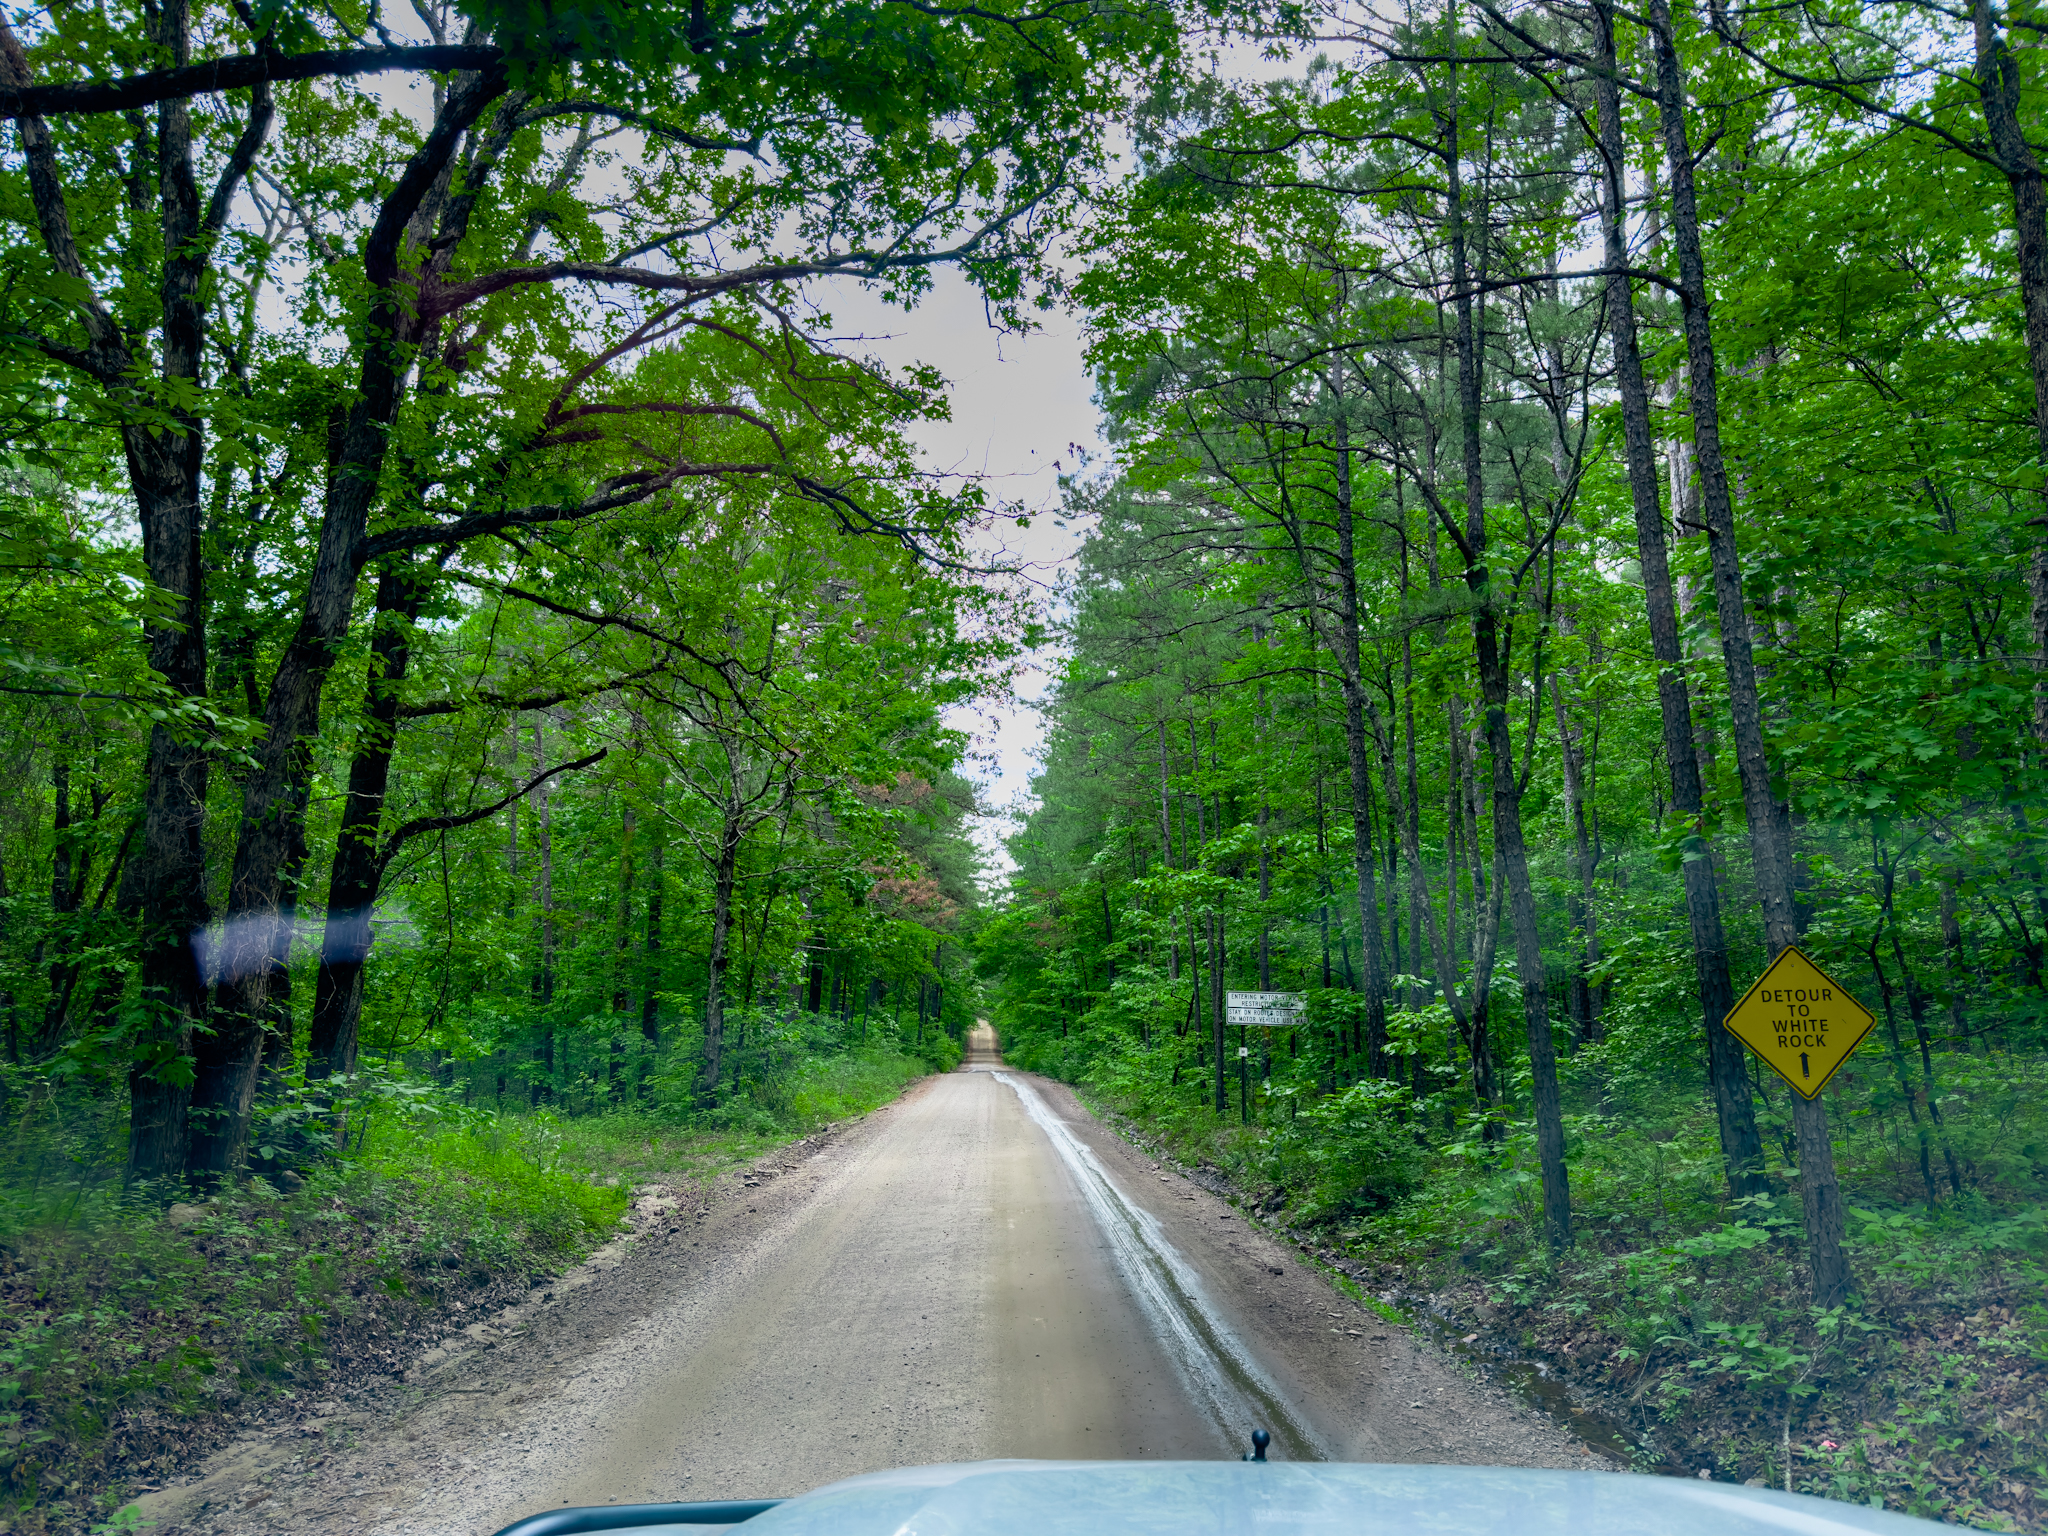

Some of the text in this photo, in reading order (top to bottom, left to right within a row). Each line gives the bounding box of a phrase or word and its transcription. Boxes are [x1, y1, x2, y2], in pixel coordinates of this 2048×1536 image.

[1761, 988, 1833, 1003] DETOUR
[1786, 1004, 1810, 1017] TO
[1772, 1019, 1830, 1032] WHITE
[1778, 1034, 1826, 1048] ROCK
